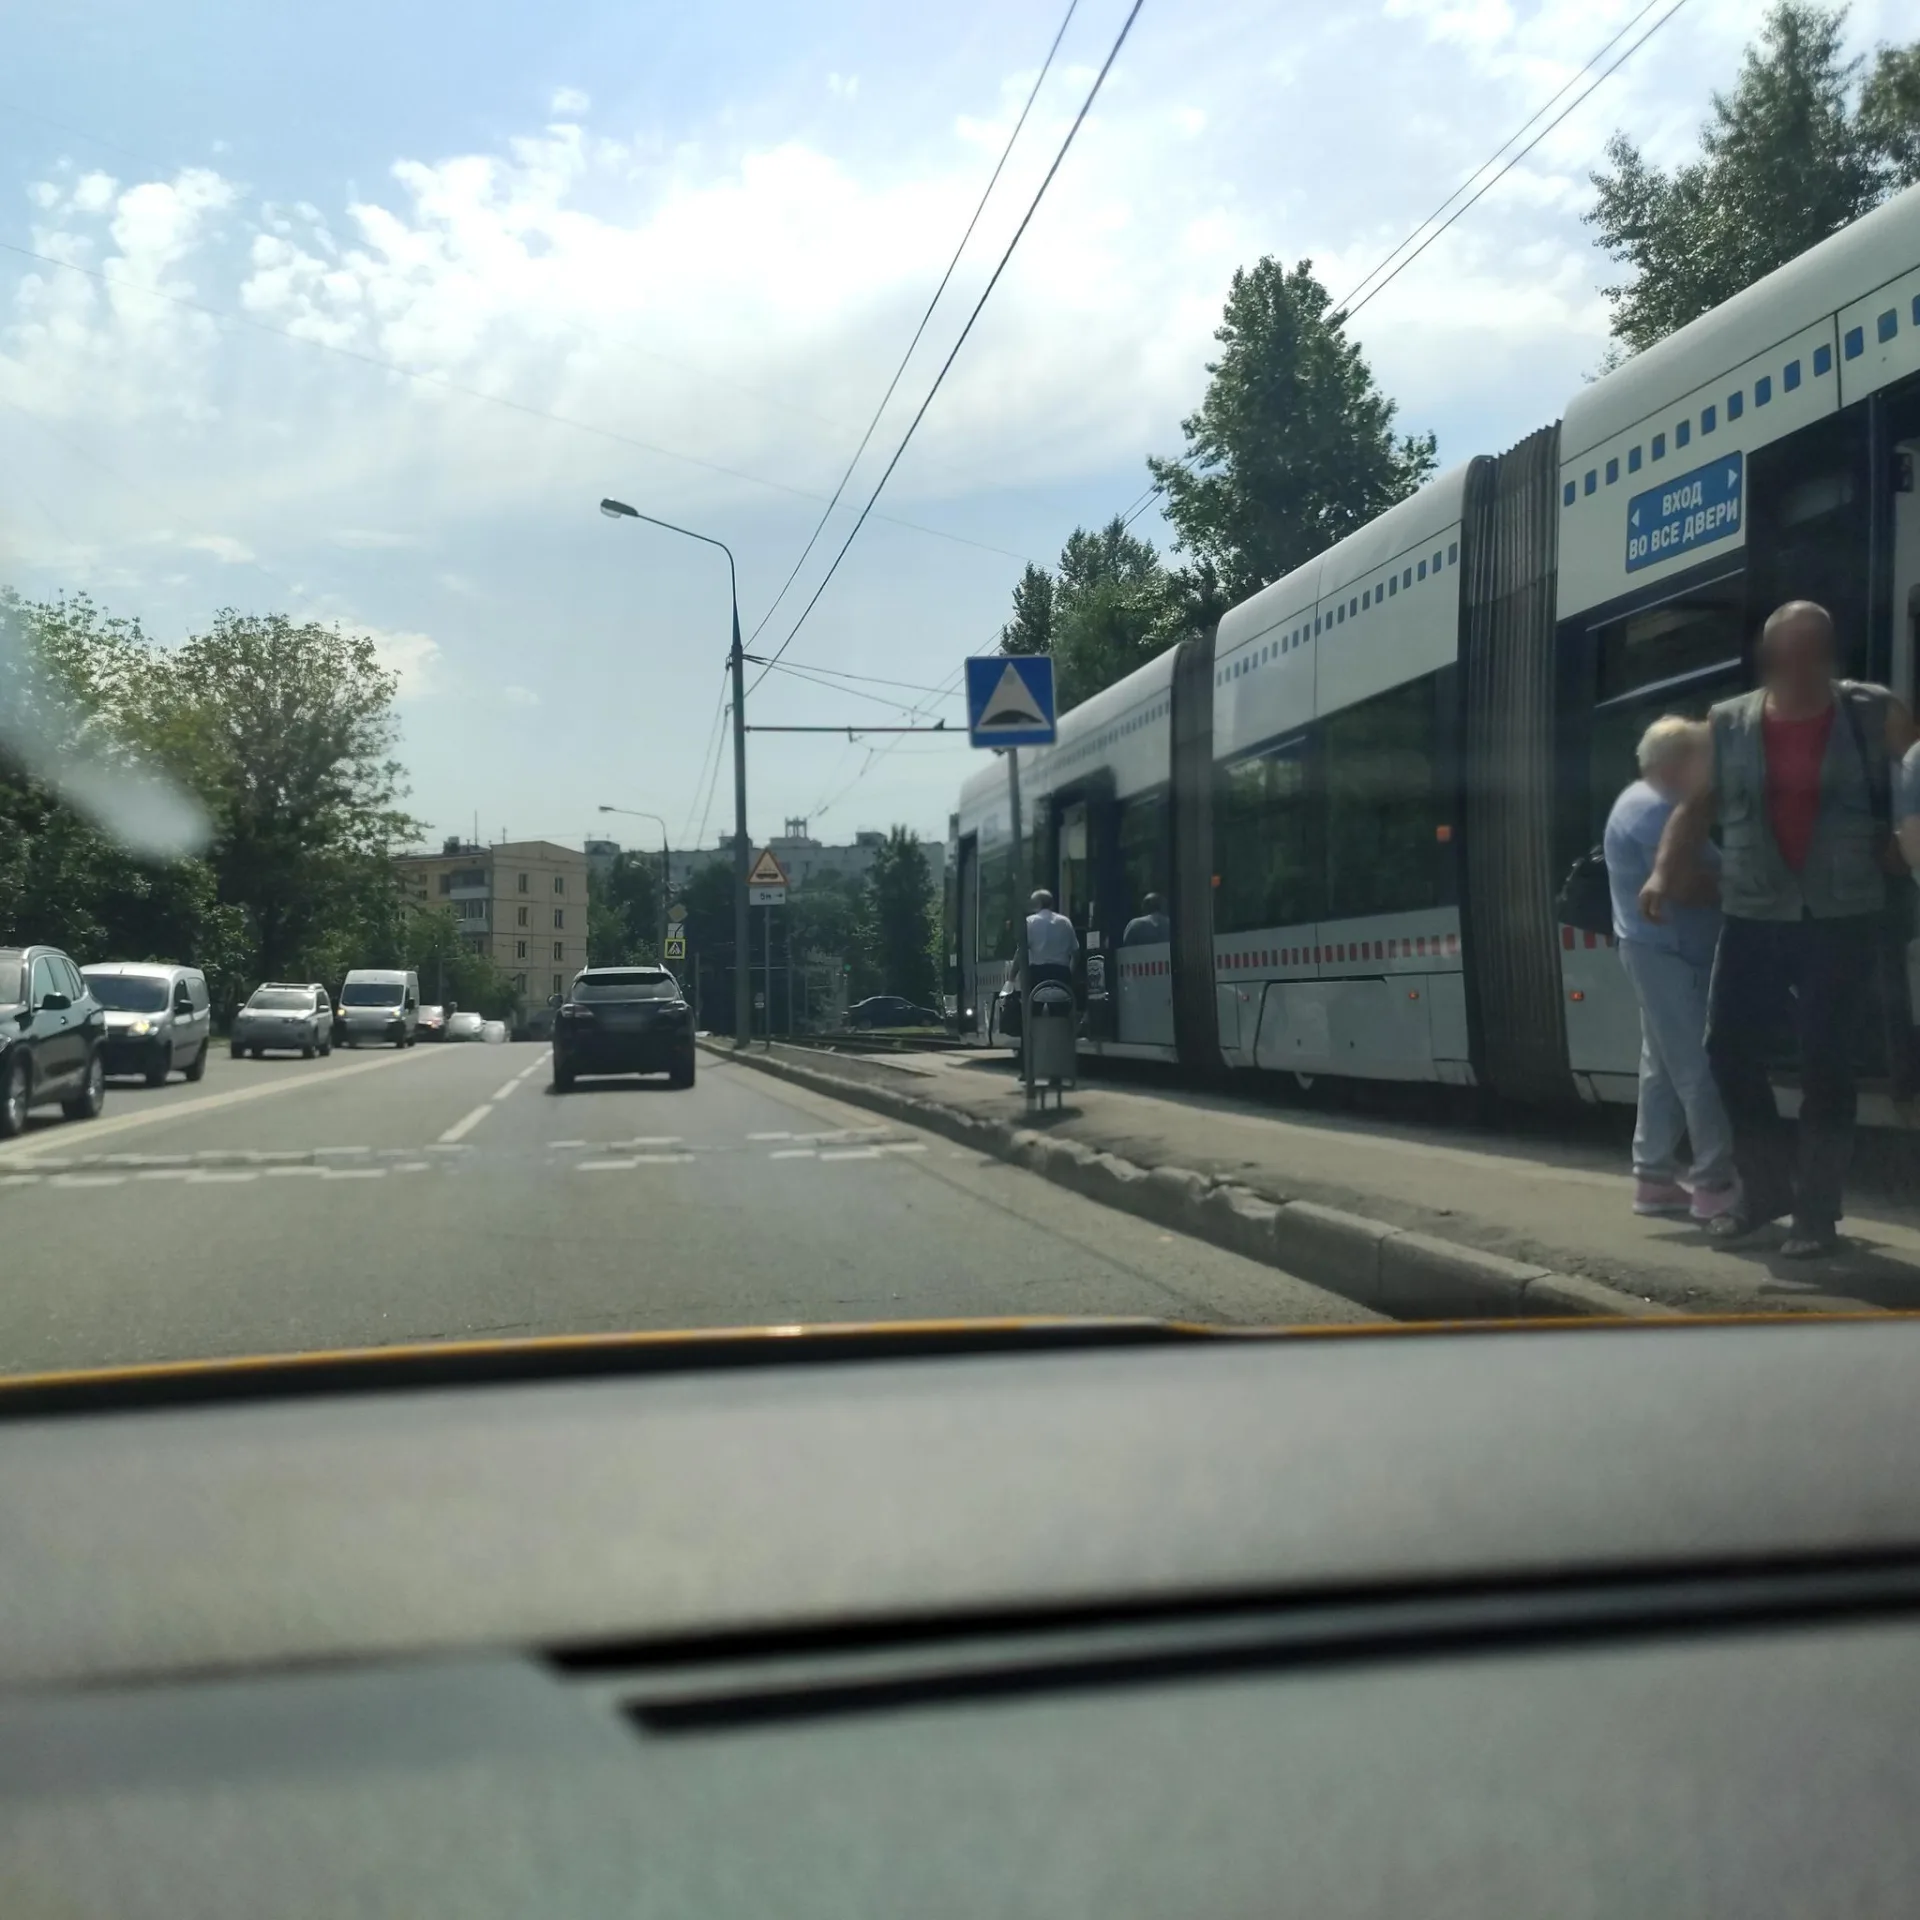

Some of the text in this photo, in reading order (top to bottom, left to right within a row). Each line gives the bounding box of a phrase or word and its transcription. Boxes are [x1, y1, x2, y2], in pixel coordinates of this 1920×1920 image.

[1662, 481, 1703, 516] ВХОД
[1629, 497, 1738, 560] ВО ВСЕ ДВЕРИ
